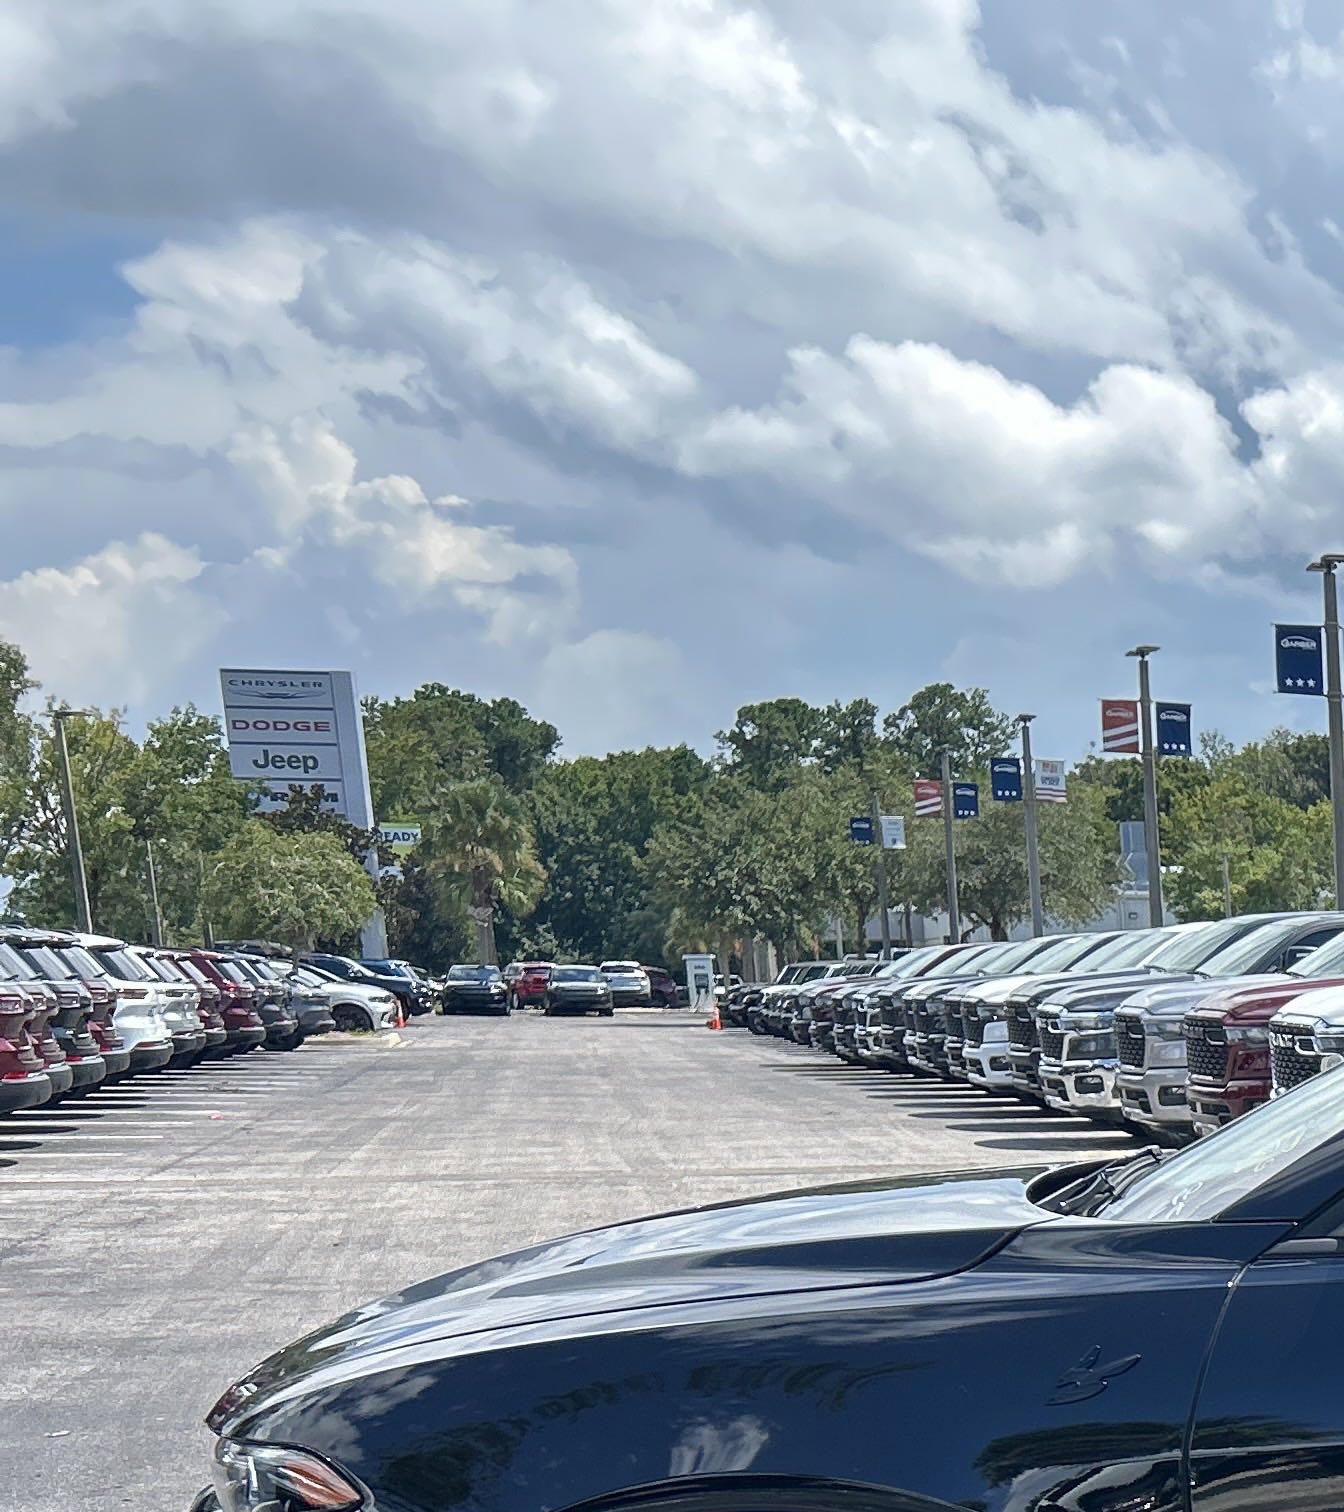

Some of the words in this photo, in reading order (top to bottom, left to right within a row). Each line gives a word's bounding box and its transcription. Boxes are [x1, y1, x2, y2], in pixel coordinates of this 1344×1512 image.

[228, 679, 323, 688] CHRYSLER
[231, 719, 331, 732] DODGE
[252, 749, 319, 774] Jeep
[270, 792, 339, 803] RM
